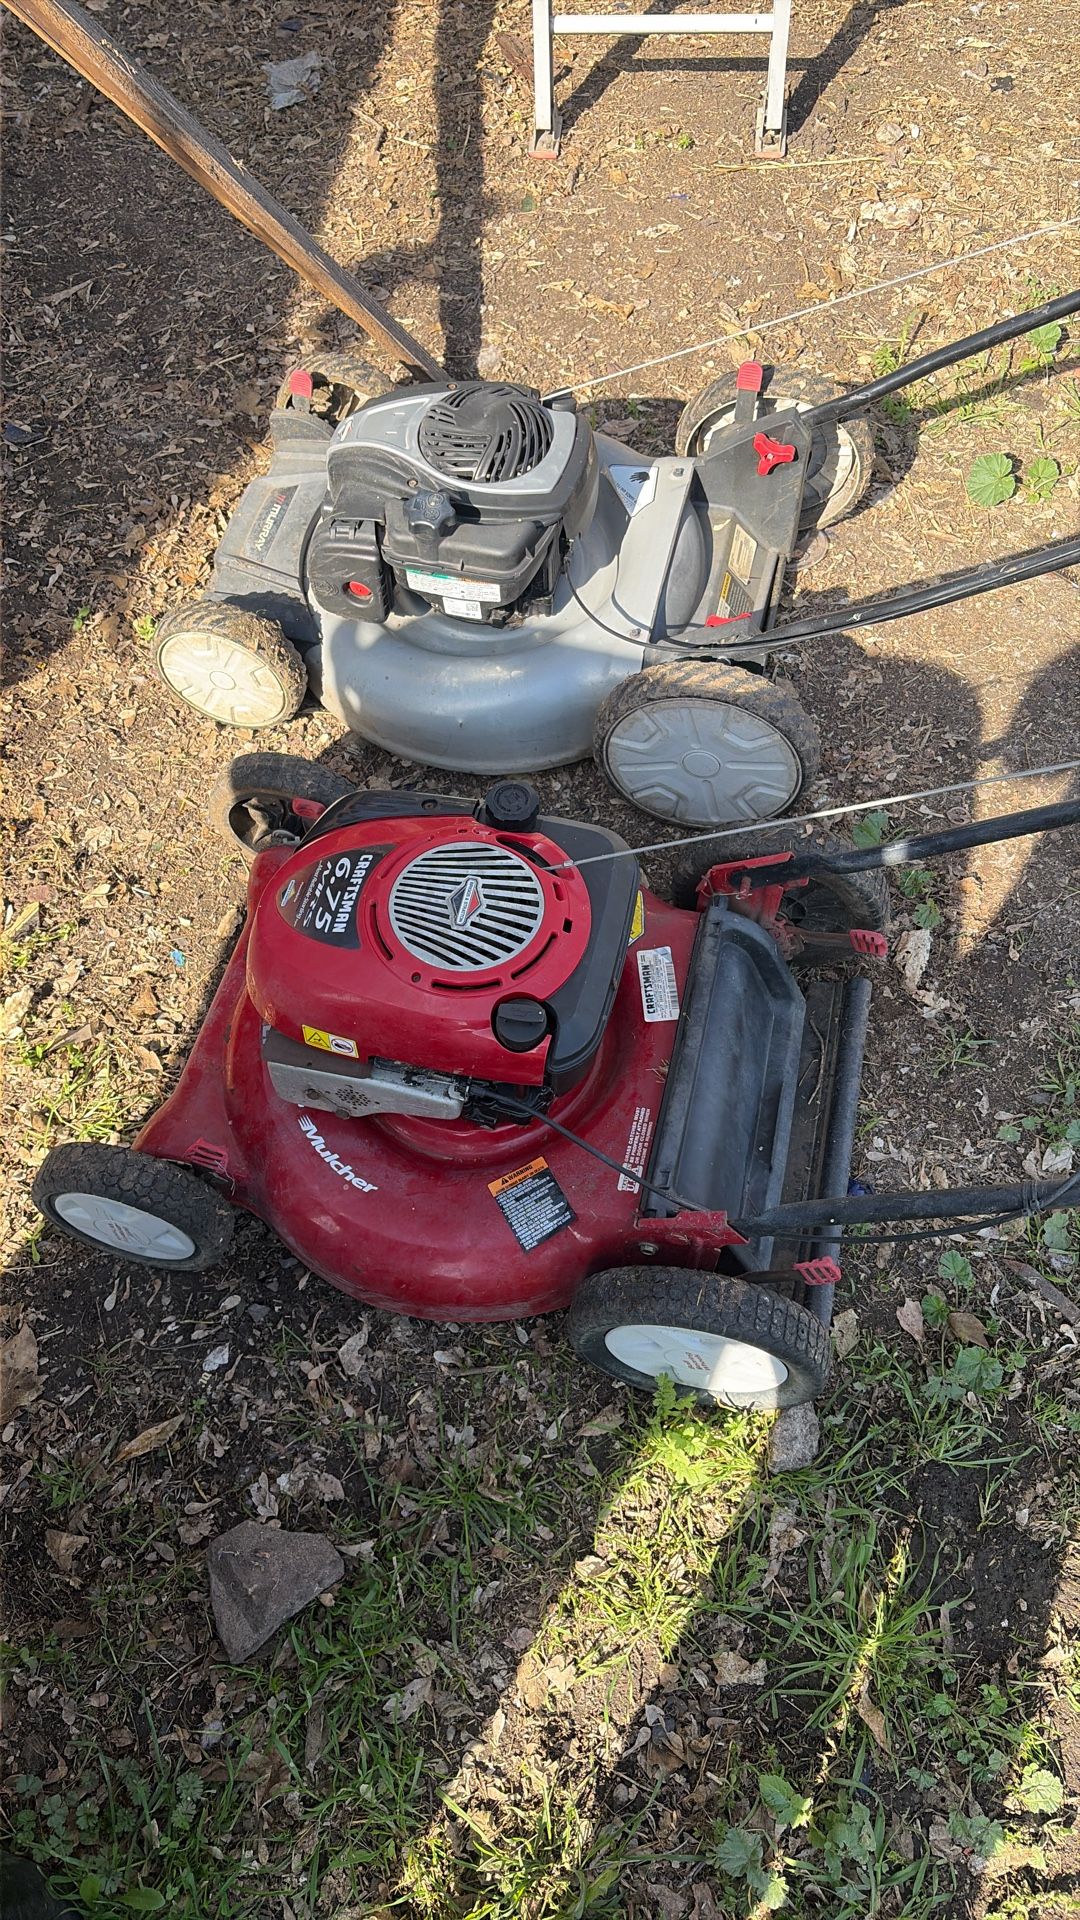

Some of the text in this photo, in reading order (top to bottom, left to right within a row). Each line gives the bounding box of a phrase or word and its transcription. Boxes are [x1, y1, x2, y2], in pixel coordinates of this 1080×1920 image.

[255, 503, 281, 551] MURRAY
[296, 896, 309, 920] Starting
[306, 876, 318, 898] Reliable
[315, 857, 351, 933] 6.75
[332, 854, 373, 933] CRAFTSMAN
[641, 964, 656, 1014] CRAFTSMAN
[298, 1114, 378, 1193] Mulcher
[507, 1164, 533, 1181] WARNING
